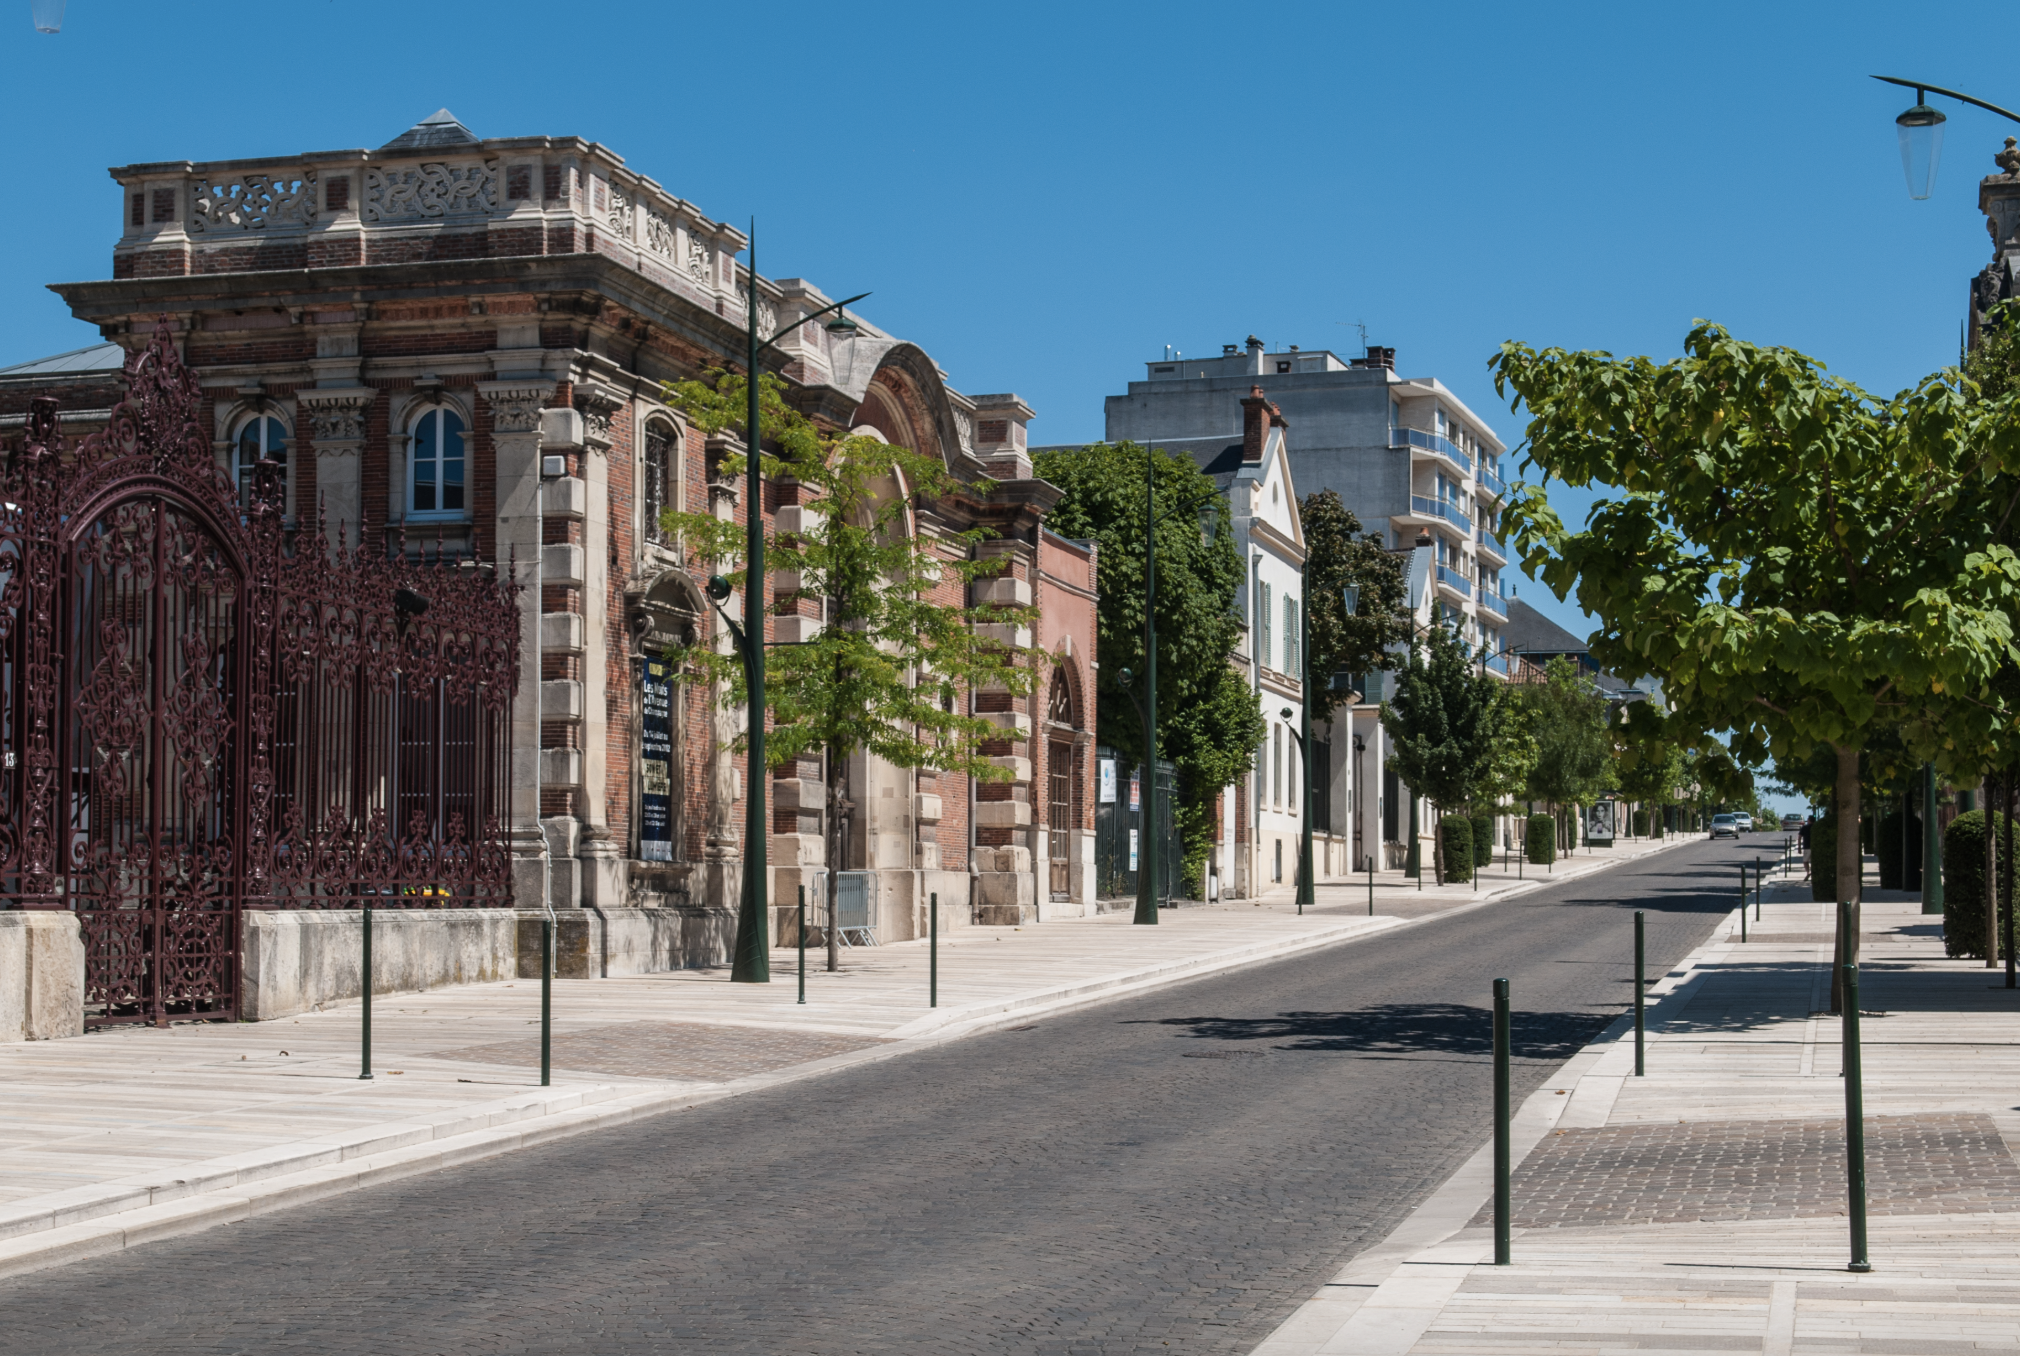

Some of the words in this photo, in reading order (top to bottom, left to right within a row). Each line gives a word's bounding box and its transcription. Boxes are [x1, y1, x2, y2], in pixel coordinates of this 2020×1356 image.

[644, 680, 654, 694] Les
[654, 682, 668, 696] Nuits
[4, 752, 15, 767] 13
